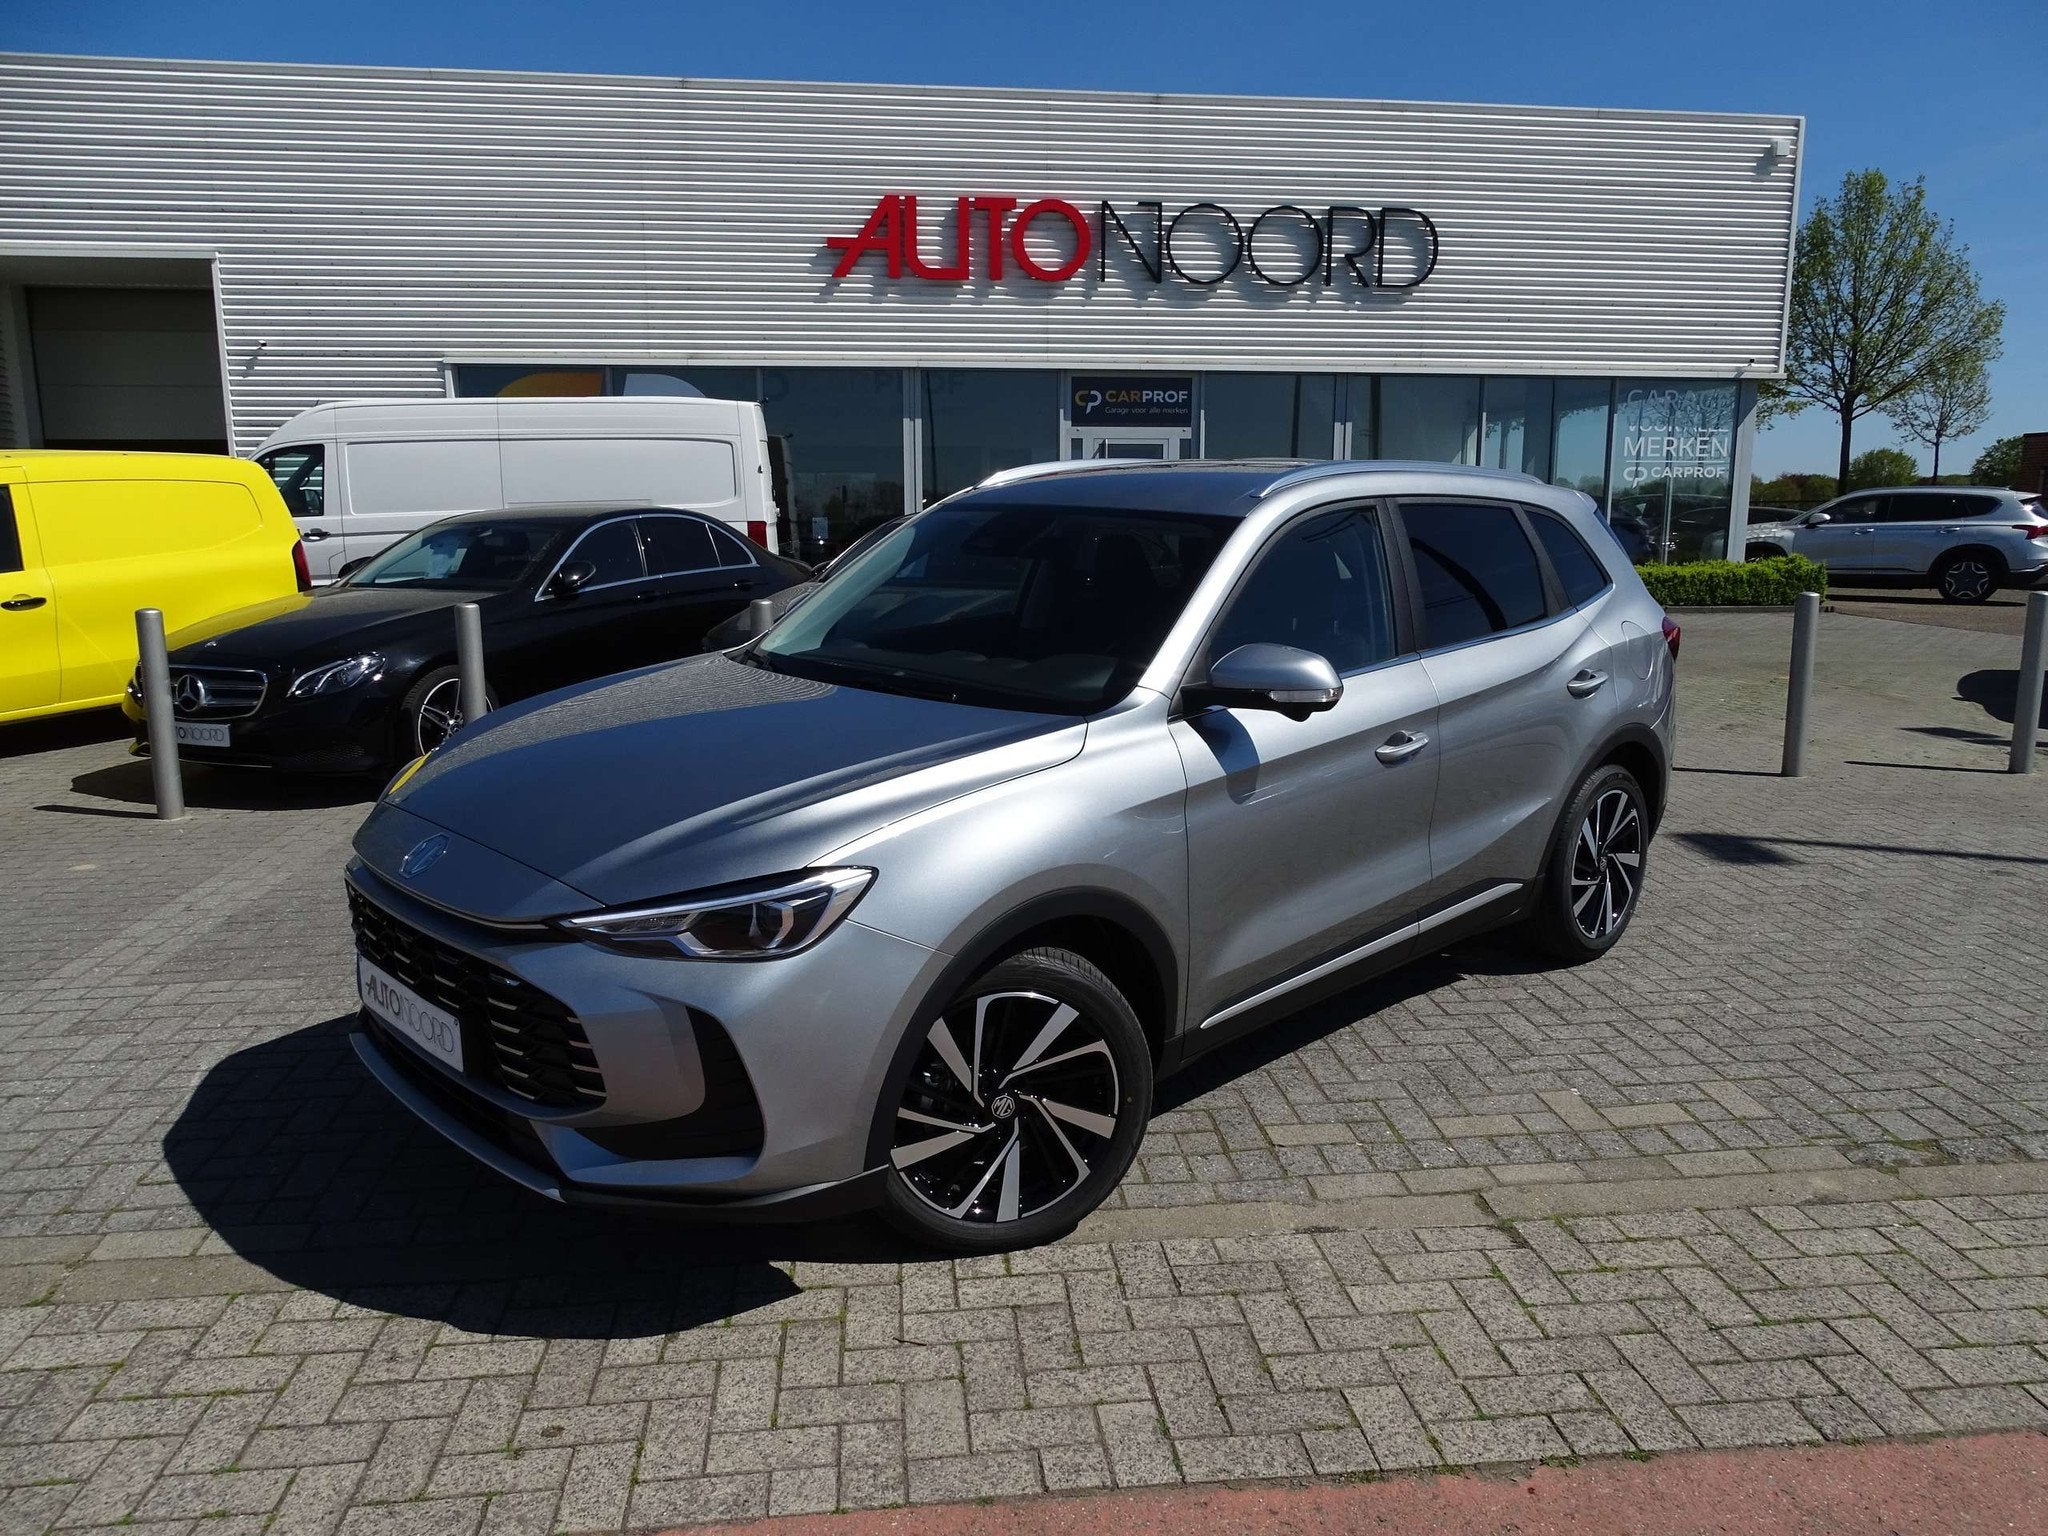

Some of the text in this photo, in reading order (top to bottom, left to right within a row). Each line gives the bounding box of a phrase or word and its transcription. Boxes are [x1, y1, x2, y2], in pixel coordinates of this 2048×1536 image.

[1105, 390, 1189, 403] CARPROF
[1105, 406, 1129, 415] Garage
[1149, 406, 1161, 414] alle
[1162, 406, 1189, 414] merken
[1623, 436, 1729, 457] MERKEN
[1651, 466, 1726, 478] CARPROF
